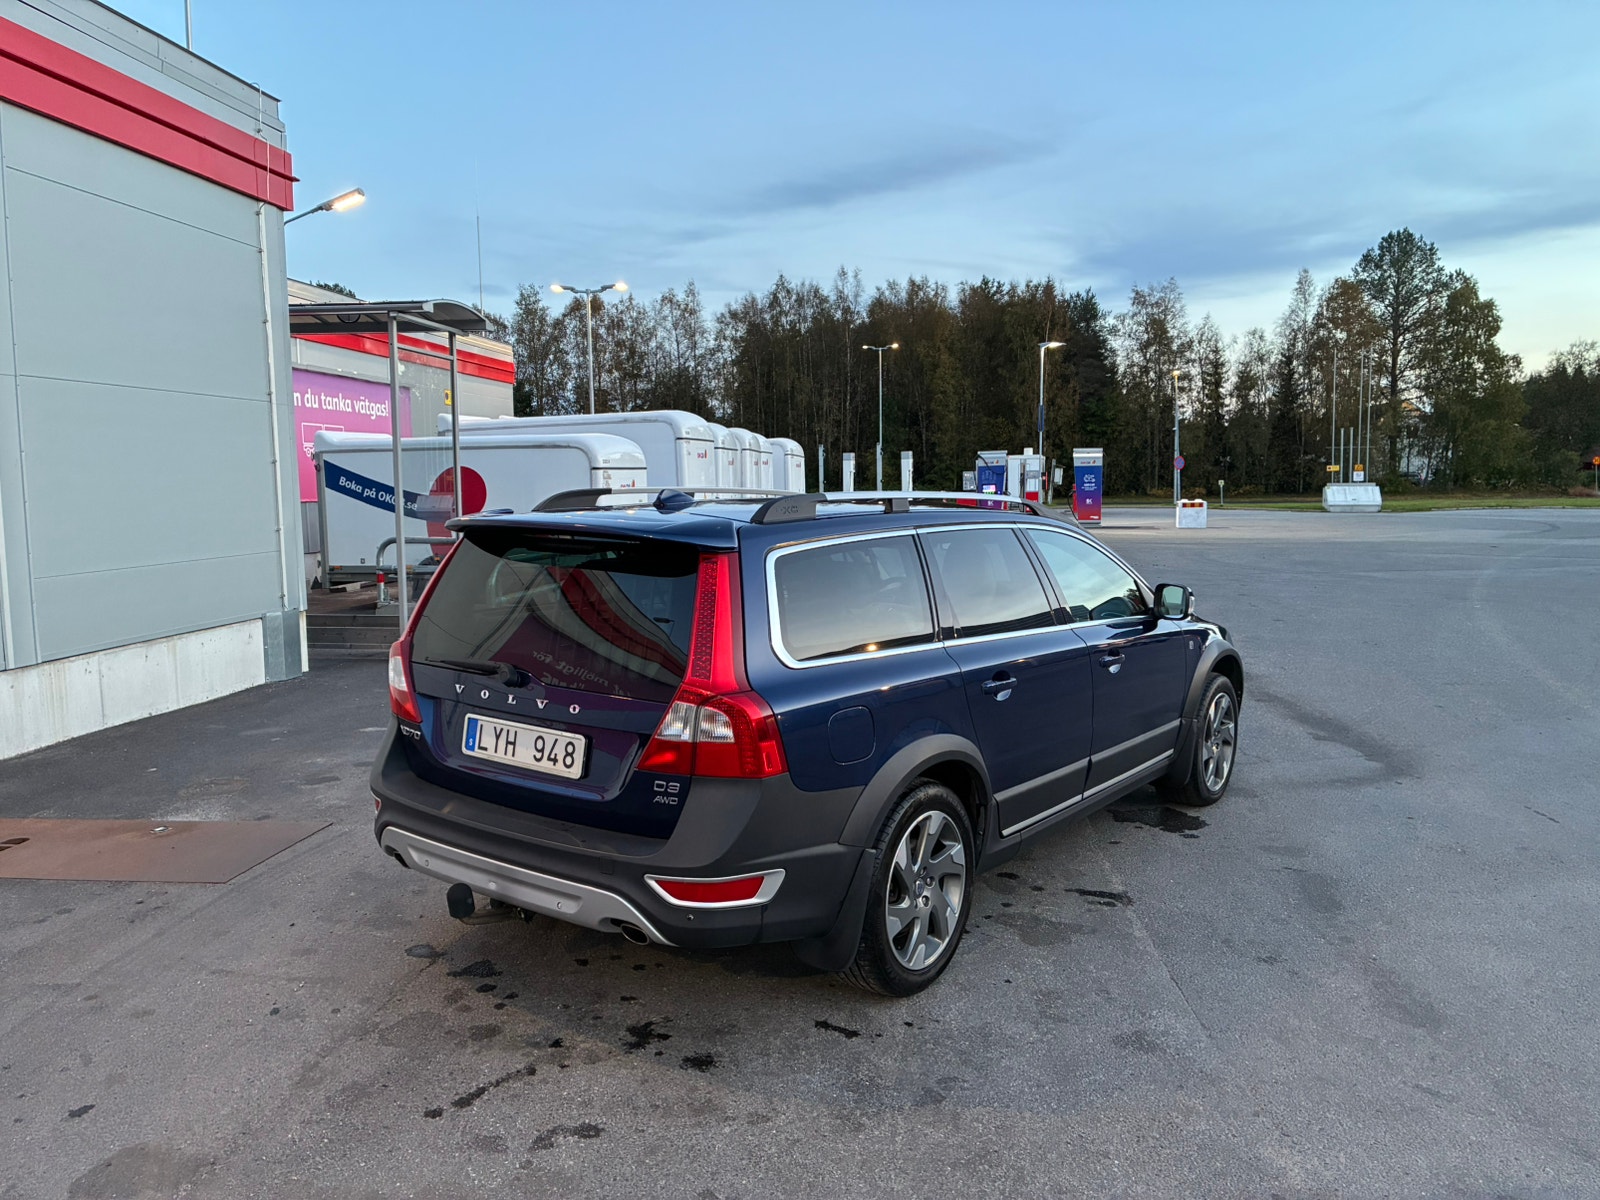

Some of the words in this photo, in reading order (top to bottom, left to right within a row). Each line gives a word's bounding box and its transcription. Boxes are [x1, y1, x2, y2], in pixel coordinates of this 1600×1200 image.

[304, 388, 319, 409] du
[321, 392, 352, 412] tanka
[354, 396, 389, 420] vätgas!
[338, 476, 362, 493] Boka
[363, 488, 376, 499] på
[378, 491, 418, 511] OK.se
[455, 683, 580, 714] VOLVO
[468, 738, 473, 746] S
[477, 723, 518, 758] LYH
[533, 735, 577, 769] 948
[653, 781, 680, 794] D3
[653, 795, 679, 805] AWD
